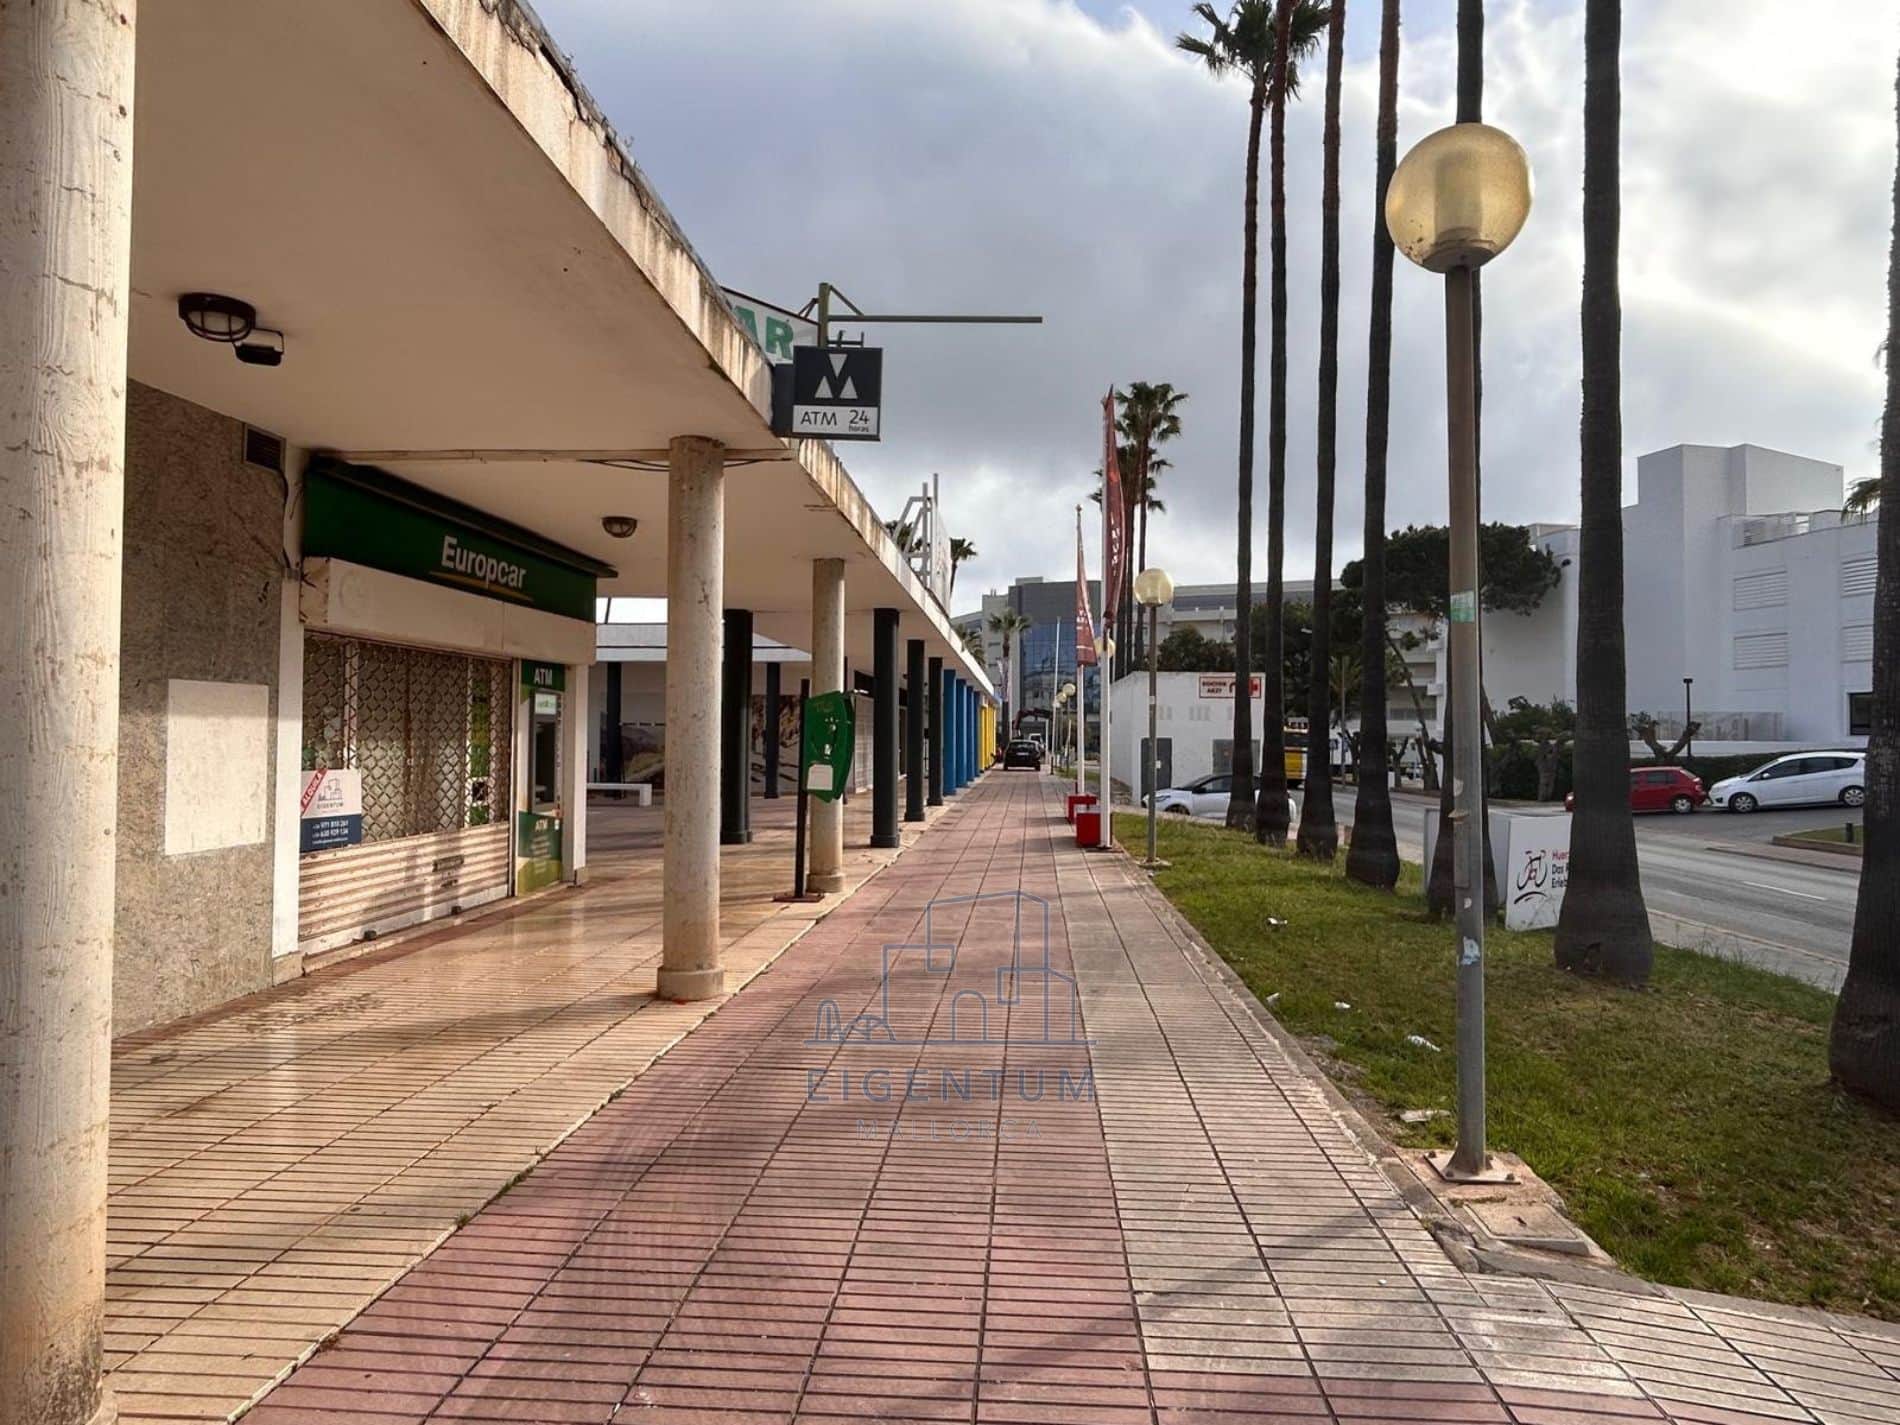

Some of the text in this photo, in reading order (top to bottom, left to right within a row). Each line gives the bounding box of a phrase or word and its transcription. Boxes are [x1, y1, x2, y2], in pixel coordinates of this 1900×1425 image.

[801, 410, 870, 426] ATM 24
[441, 535, 527, 589] Europcar
[534, 669, 552, 685] ATM
